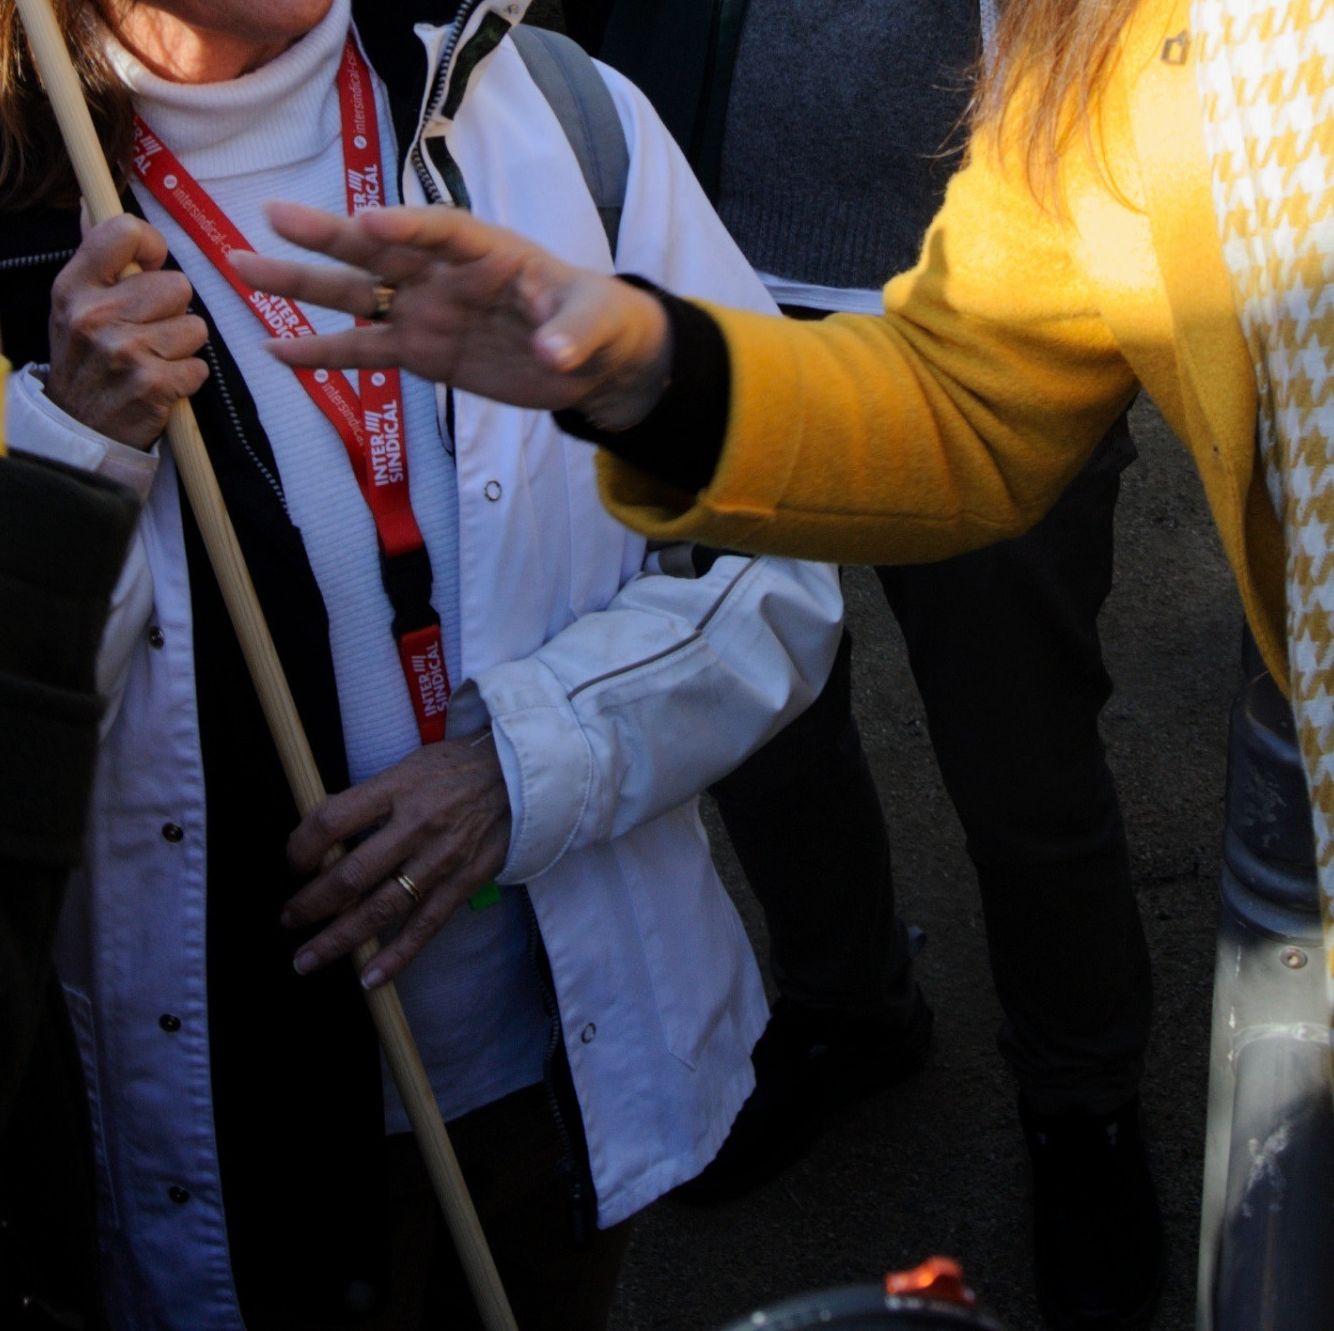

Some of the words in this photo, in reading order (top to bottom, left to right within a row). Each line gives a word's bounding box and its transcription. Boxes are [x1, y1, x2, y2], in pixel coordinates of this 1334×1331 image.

[370, 433, 389, 487] INTER
[382, 399, 403, 483] SINDICAL
[418, 673, 438, 718] INTER
[426, 641, 449, 713] SINDICAL
